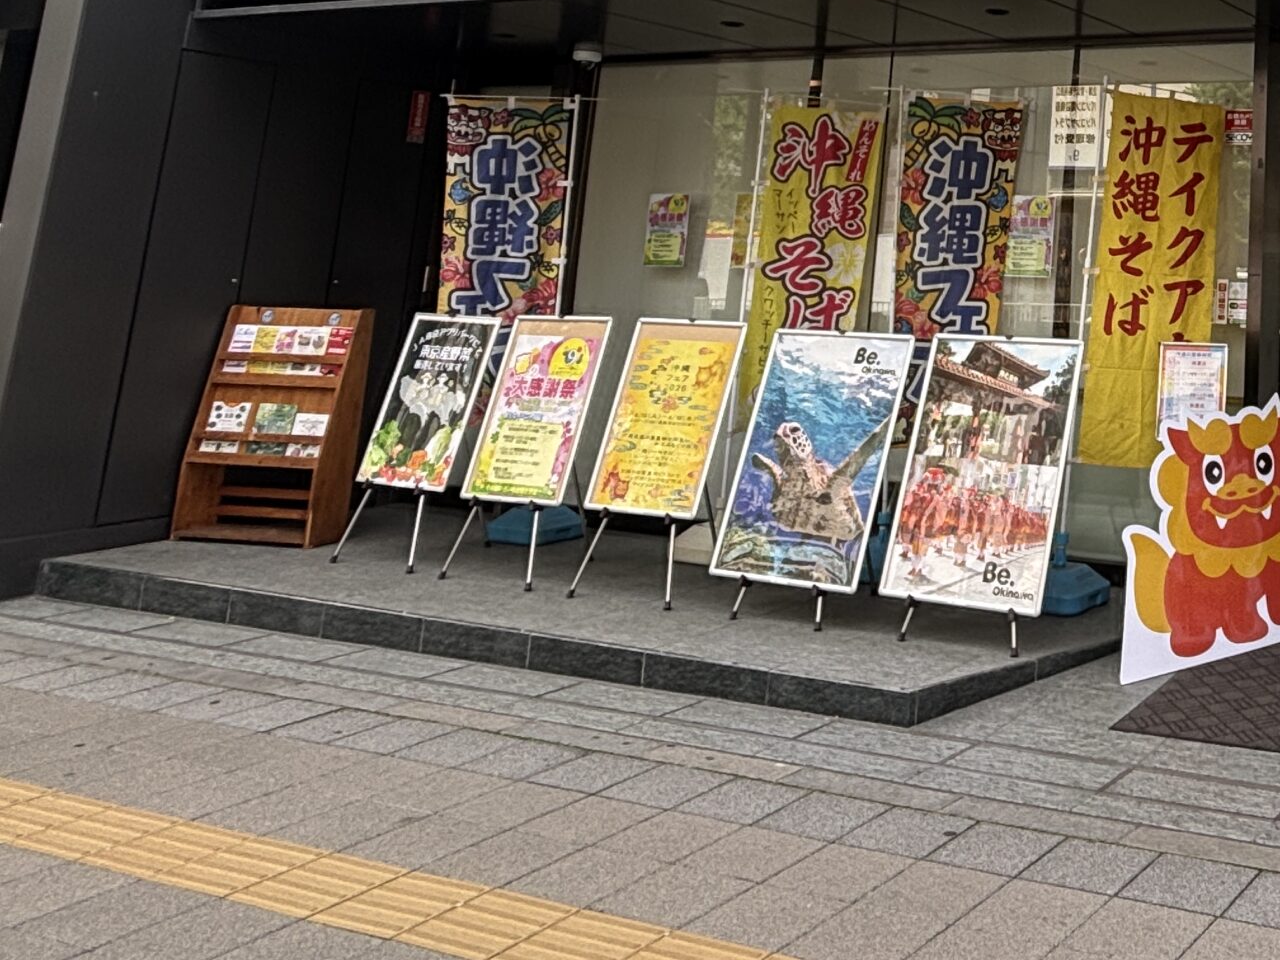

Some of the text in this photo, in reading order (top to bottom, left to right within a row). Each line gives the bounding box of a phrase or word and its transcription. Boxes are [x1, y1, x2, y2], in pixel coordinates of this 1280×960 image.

[763, 114, 868, 330] 沖縄そば
[914, 136, 993, 334] 沖縄フェ
[1103, 114, 1166, 337] 沖縄そば
[1163, 121, 1214, 341] テイクア
[419, 344, 473, 362] 東京産野菜
[512, 378, 578, 399] 大感謝祭
